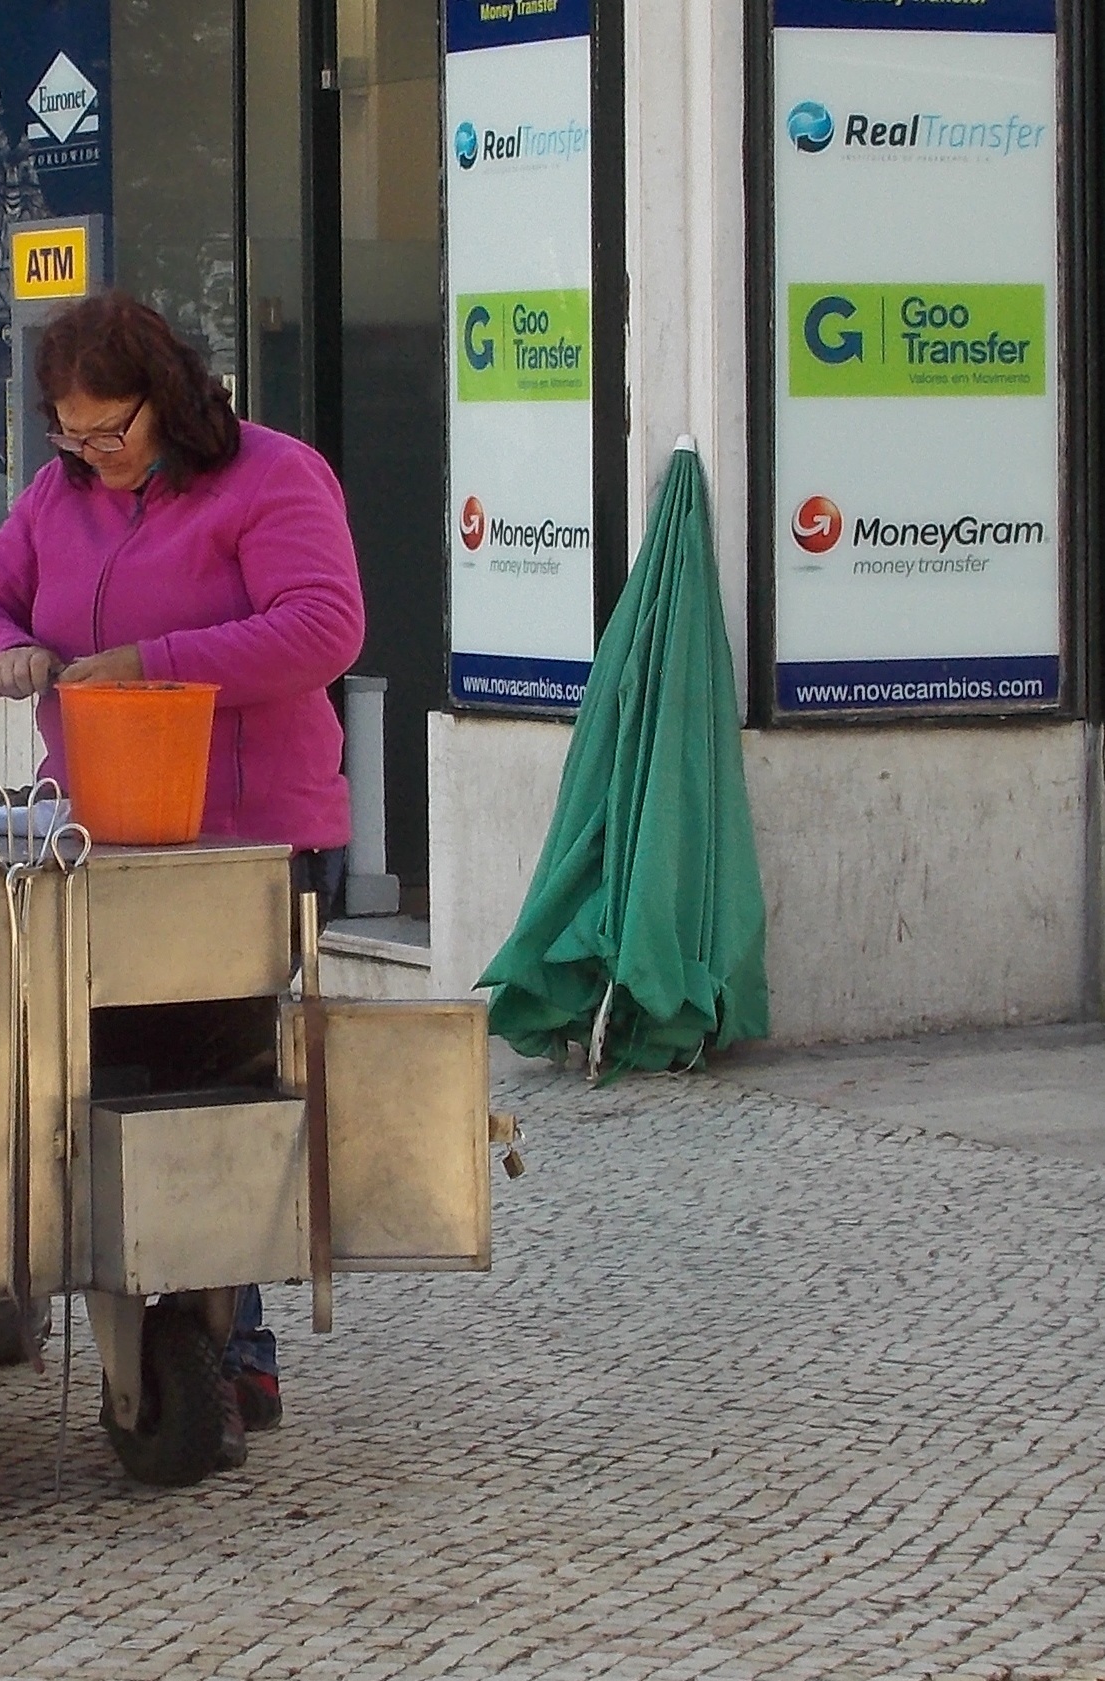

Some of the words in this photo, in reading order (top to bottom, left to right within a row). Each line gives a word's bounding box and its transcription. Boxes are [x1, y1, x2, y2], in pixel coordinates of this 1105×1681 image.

[480, 3, 514, 22] Money
[516, 0, 557, 16] Transfer
[38, 86, 87, 114] Euronet
[483, 120, 589, 161] RealTransfer
[844, 113, 1047, 157] RealTransfer
[26, 246, 74, 284] ATM
[513, 304, 549, 335] Goo
[901, 297, 969, 329] Goo
[513, 336, 582, 370] Transfer
[901, 331, 1031, 364] Transfer
[489, 518, 590, 555] MoneyGram
[853, 516, 1044, 553] MoneyGram
[490, 559, 522, 577] money
[524, 557, 561, 574] transfer
[853, 559, 915, 577] money
[919, 554, 990, 574] transfer
[796, 677, 1043, 702] www.novacambios.com
